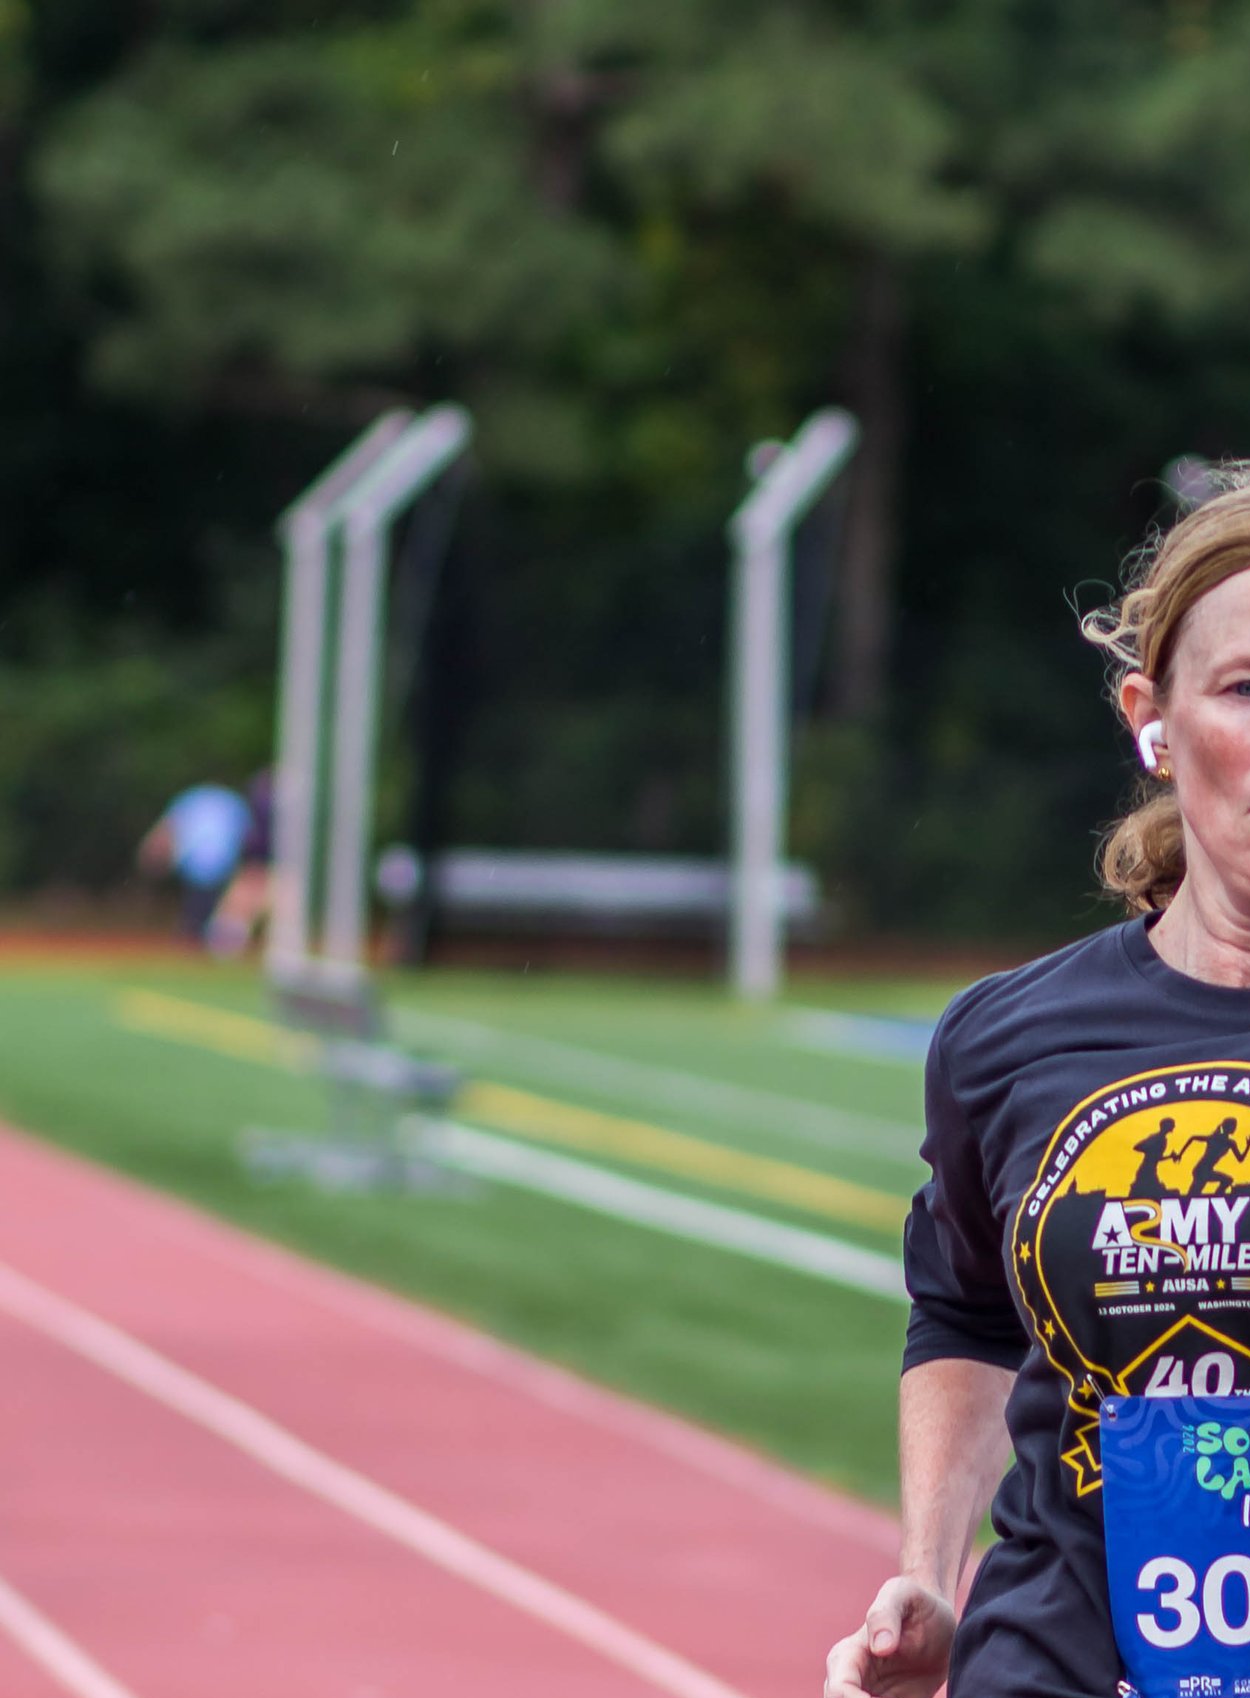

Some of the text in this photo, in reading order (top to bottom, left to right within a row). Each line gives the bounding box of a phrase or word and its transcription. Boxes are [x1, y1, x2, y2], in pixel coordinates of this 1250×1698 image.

[1028, 1083, 1166, 1217] CELEBRATING
[1175, 1073, 1229, 1095] THE
[1092, 1196, 1250, 1250] ARMY
[1162, 1277, 1210, 1294] AUSA
[1109, 1303, 1152, 1316] OCTOBER
[1154, 1303, 1176, 1312] 2024
[1190, 1675, 1213, 1692] PR
